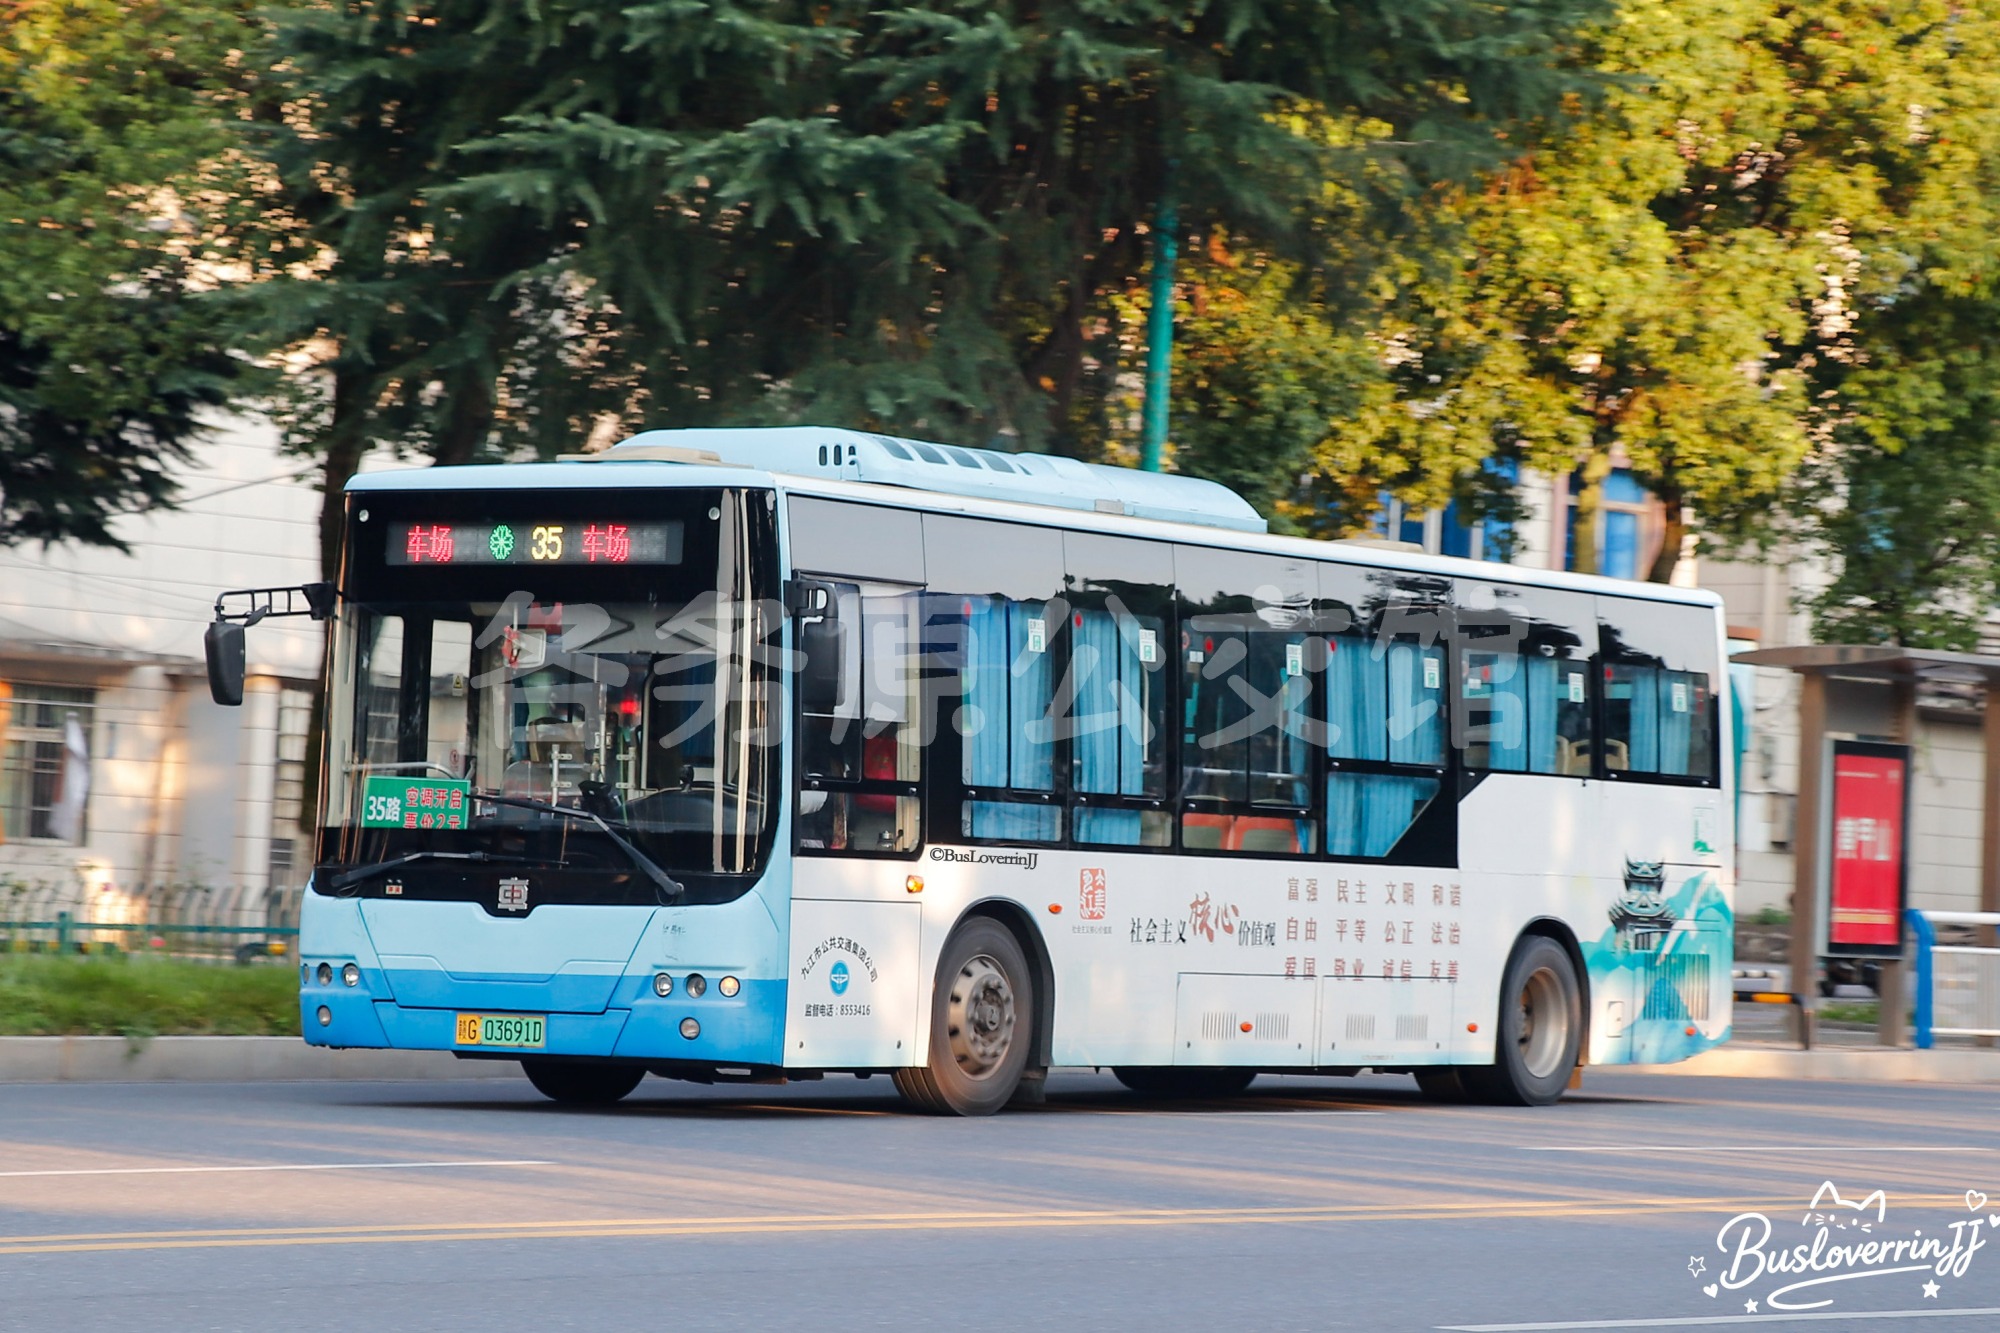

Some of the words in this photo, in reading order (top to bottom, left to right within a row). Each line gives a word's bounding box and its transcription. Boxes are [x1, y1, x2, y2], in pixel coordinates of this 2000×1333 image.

[406, 524, 455, 563] 车场
[531, 525, 564, 561] 35
[581, 524, 631, 563] 车场
[366, 795, 401, 822] 35路
[405, 786, 462, 810] 空调开启
[1288, 877, 1318, 902] 富强
[1337, 879, 1367, 904] 民主
[1385, 881, 1415, 906] 文明
[1432, 883, 1461, 907] 和谐
[1286, 917, 1317, 941] 自由
[1336, 919, 1366, 943] 平等
[1384, 920, 1414, 945] 公正
[1431, 921, 1460, 945] 法治
[801, 936, 878, 983] 九江市公共交通集团公司
[485, 1020, 542, 1042] 03691D
